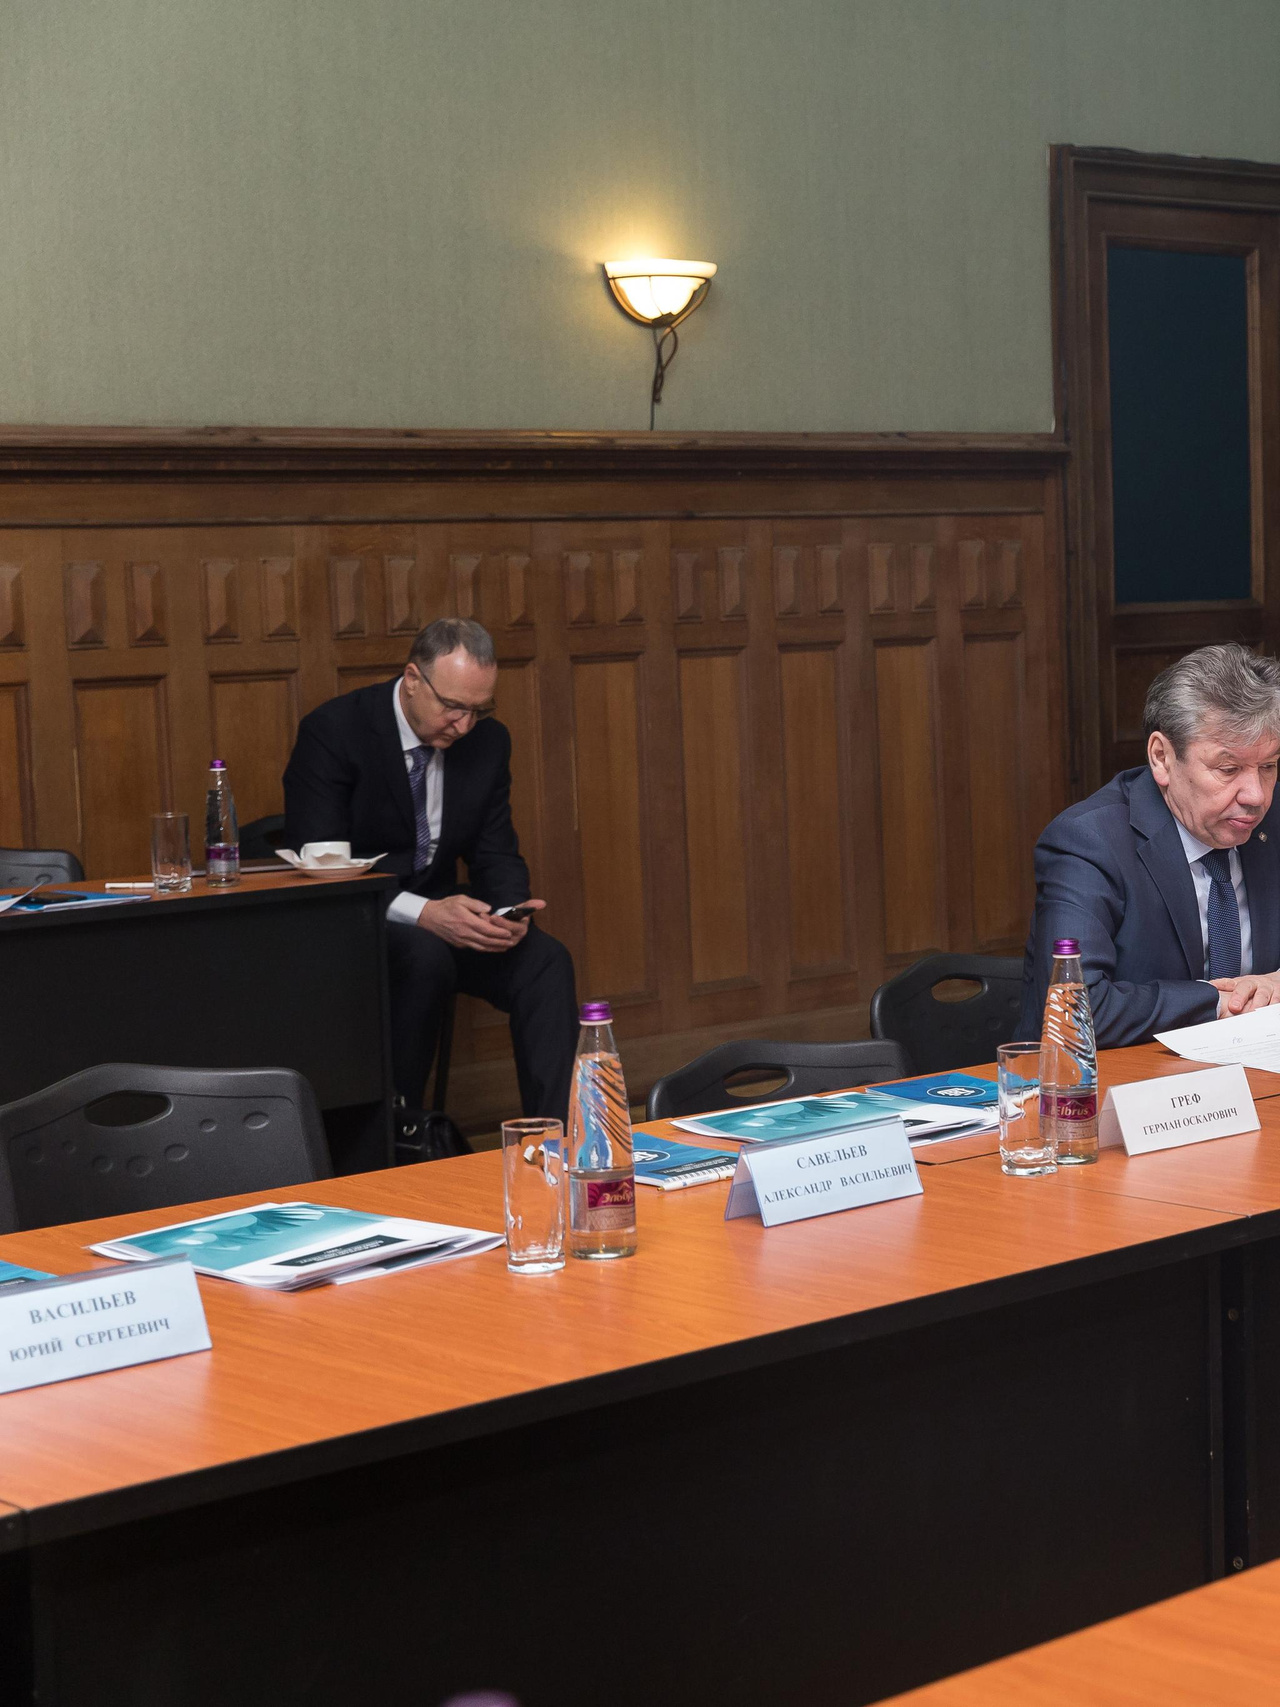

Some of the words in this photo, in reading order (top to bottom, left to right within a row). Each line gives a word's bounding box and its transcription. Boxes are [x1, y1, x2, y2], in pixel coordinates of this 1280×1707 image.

[1170, 1093, 1201, 1109] ГРЕФ
[1143, 1119, 1182, 1135] ГЕРМАН
[1182, 1107, 1238, 1127] ОСКАРОВИЧ
[796, 1144, 868, 1169] САВЕЛЬЕВ
[763, 1180, 833, 1204] АЛЕКСАНДР
[840, 1163, 913, 1188] ВАСИЛЬЕВИЧ
[29, 1290, 137, 1325] ВАСИЛЬЕВ
[9, 1337, 63, 1362] ЮРИЙ
[75, 1318, 170, 1348] СЕРГЕЕВИЧ
